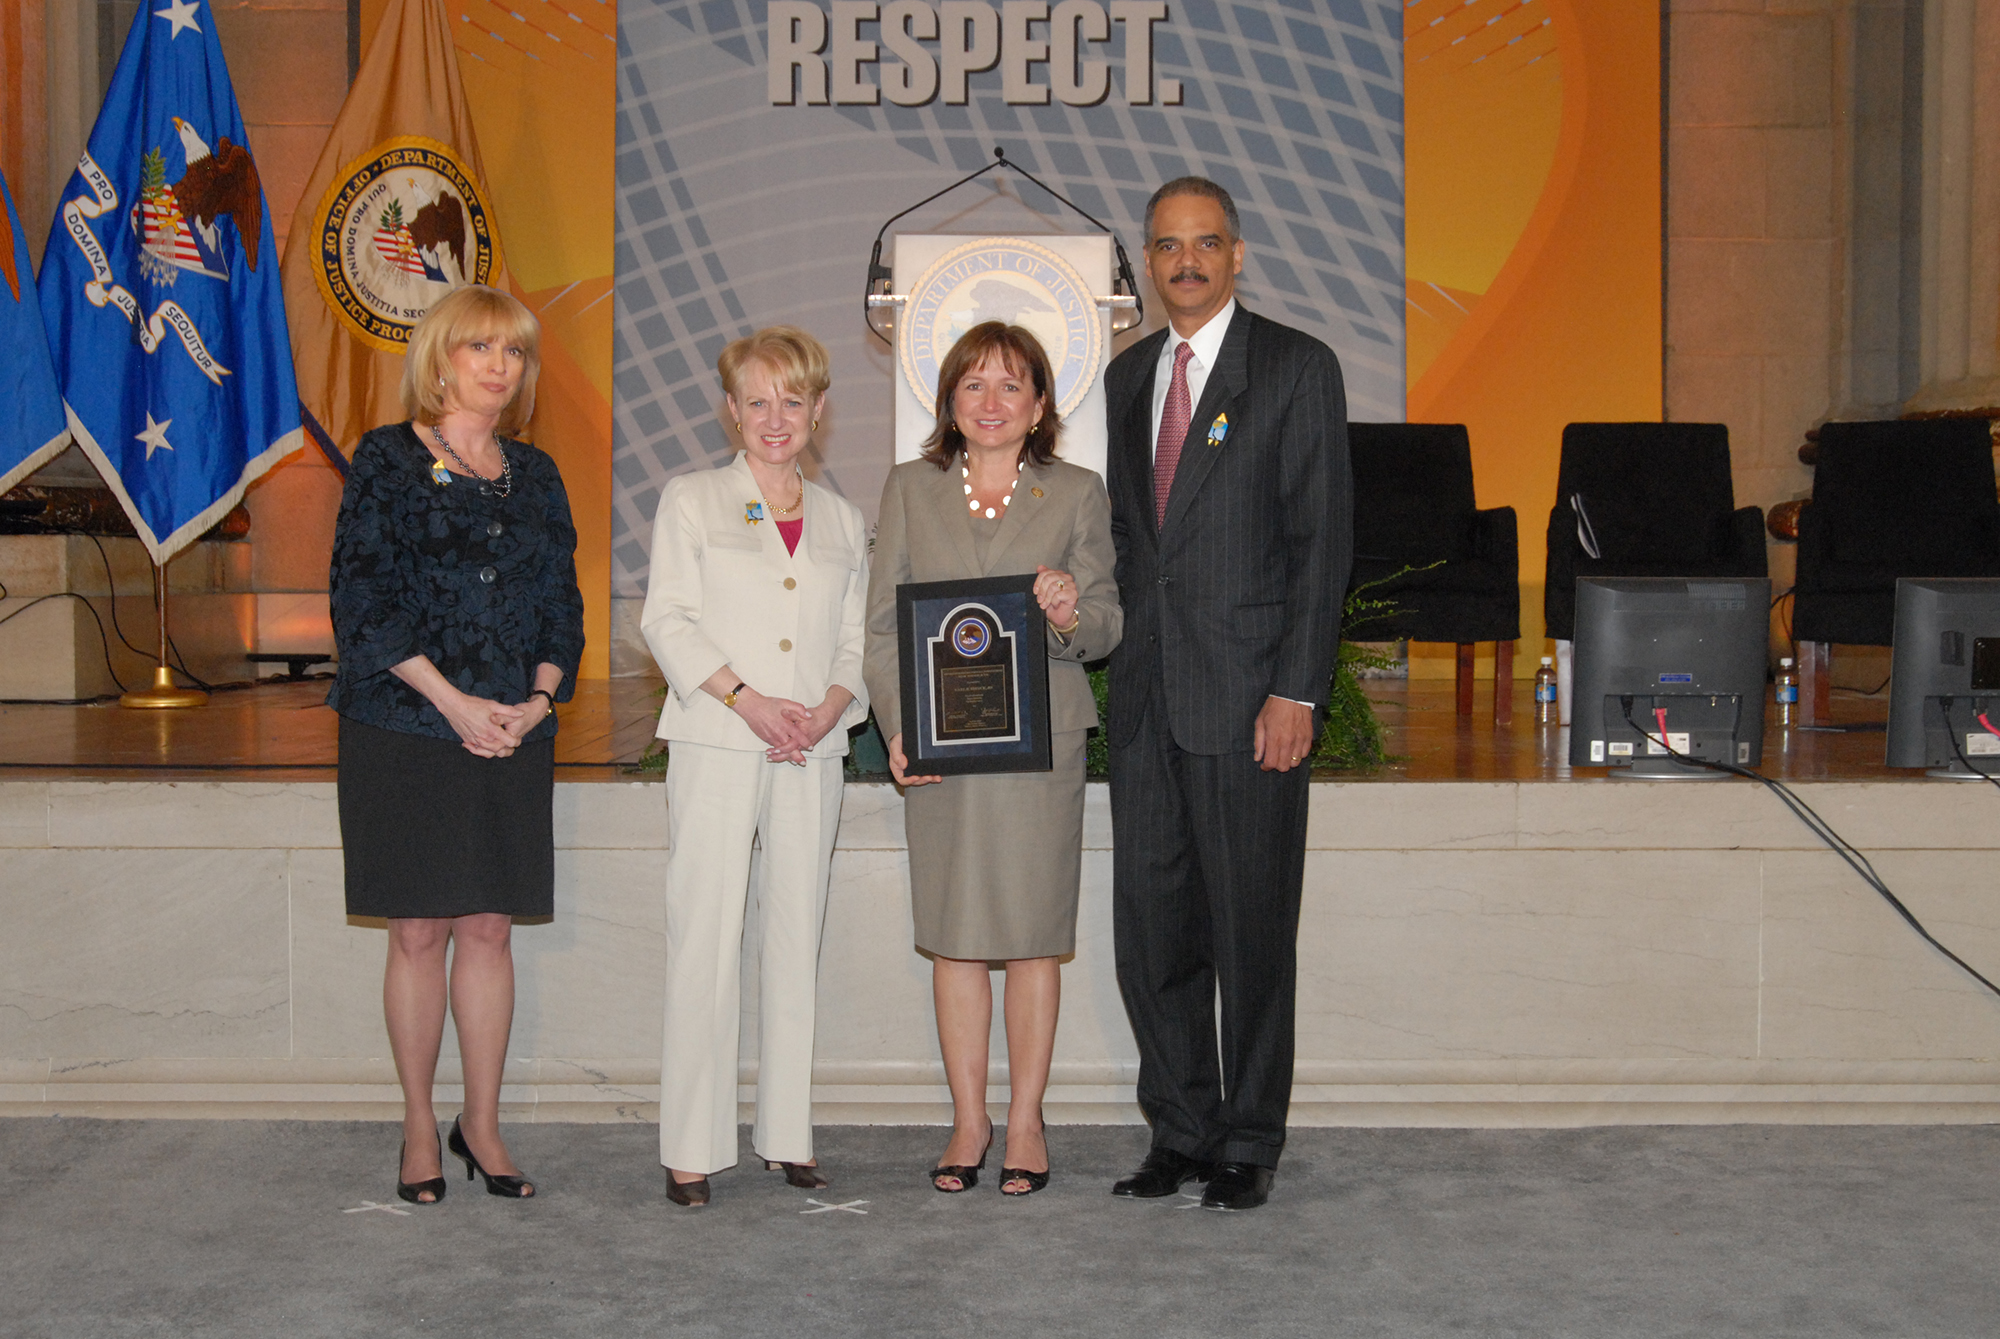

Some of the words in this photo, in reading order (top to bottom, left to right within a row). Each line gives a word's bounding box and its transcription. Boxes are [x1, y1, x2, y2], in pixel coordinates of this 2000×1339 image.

[767, 0, 1184, 107] RESPECT.
[79, 152, 90, 168] UI
[90, 171, 113, 200] PRO
[328, 170, 371, 231] OFFICE
[353, 200, 369, 224] PRO
[368, 182, 387, 202] QUI
[381, 150, 477, 208] DEPARTMENT
[474, 215, 488, 239] OF
[68, 213, 107, 277] DOMINA
[324, 234, 338, 256] OF
[345, 226, 358, 279] DOMINA
[326, 260, 370, 327] JUSTICE
[356, 281, 398, 316] JUSTITIA
[915, 253, 1008, 361] DEPARTMENT
[1015, 257, 1047, 276] OF
[165, 306, 212, 370] SEQUITUR
